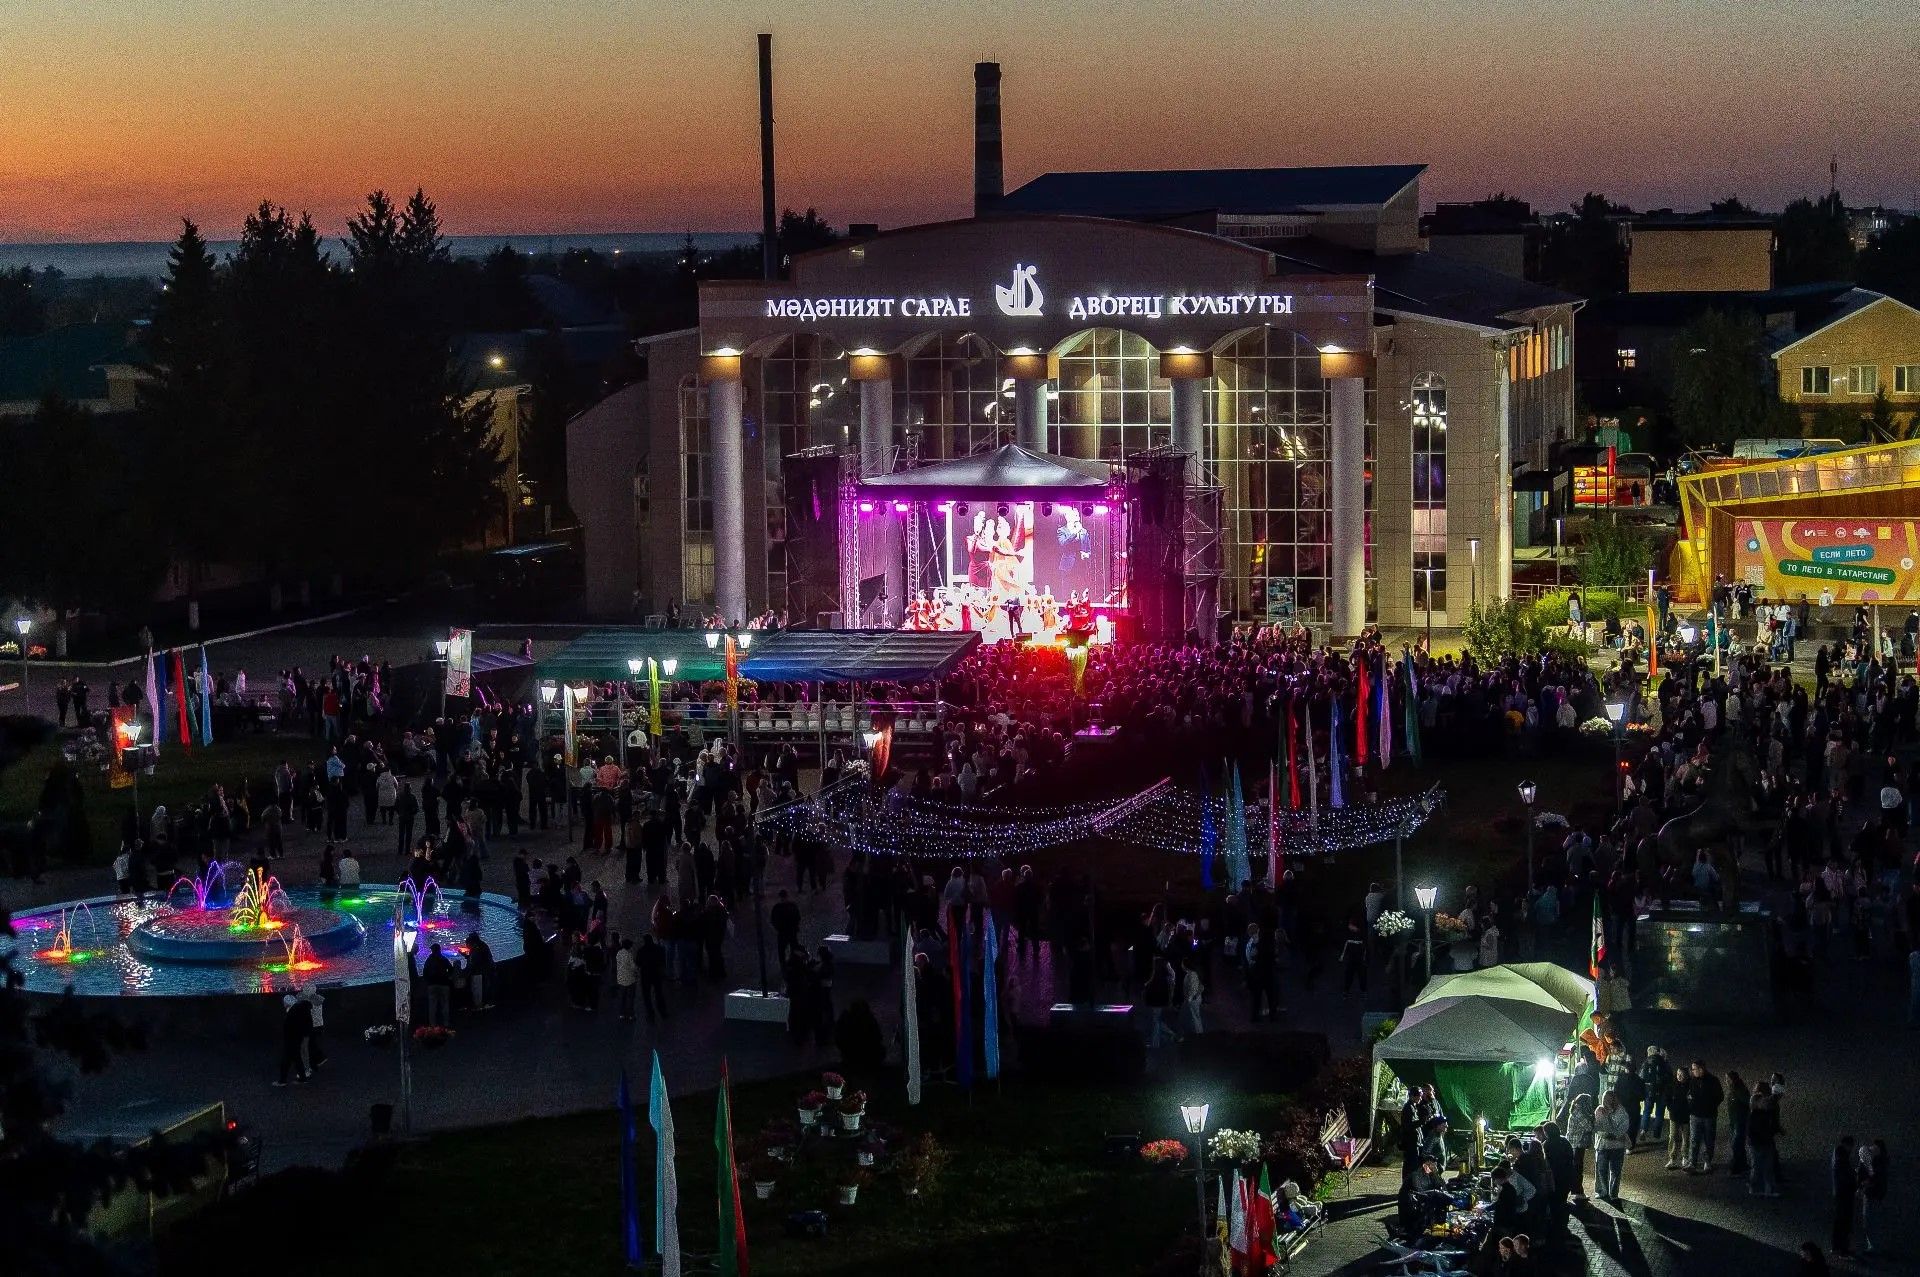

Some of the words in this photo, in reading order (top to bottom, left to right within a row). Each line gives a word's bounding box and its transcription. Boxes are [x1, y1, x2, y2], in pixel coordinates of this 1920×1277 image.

[767, 299, 895, 321] МӘДӘНИЯТ
[901, 298, 970, 316] САРАЕ
[1069, 296, 1162, 320] ДВОРЕЦ
[1172, 295, 1293, 314] КУЛЬТУРЫ
[1820, 551, 1840, 559] ЕСЛИ
[1845, 549, 1867, 558] ЛЕТО
[1787, 564, 1797, 572] ТО
[1801, 566, 1823, 574] ЛЕТО
[1827, 567, 1833, 575] В
[1837, 568, 1889, 581] ТАТАРСТАНЕ
